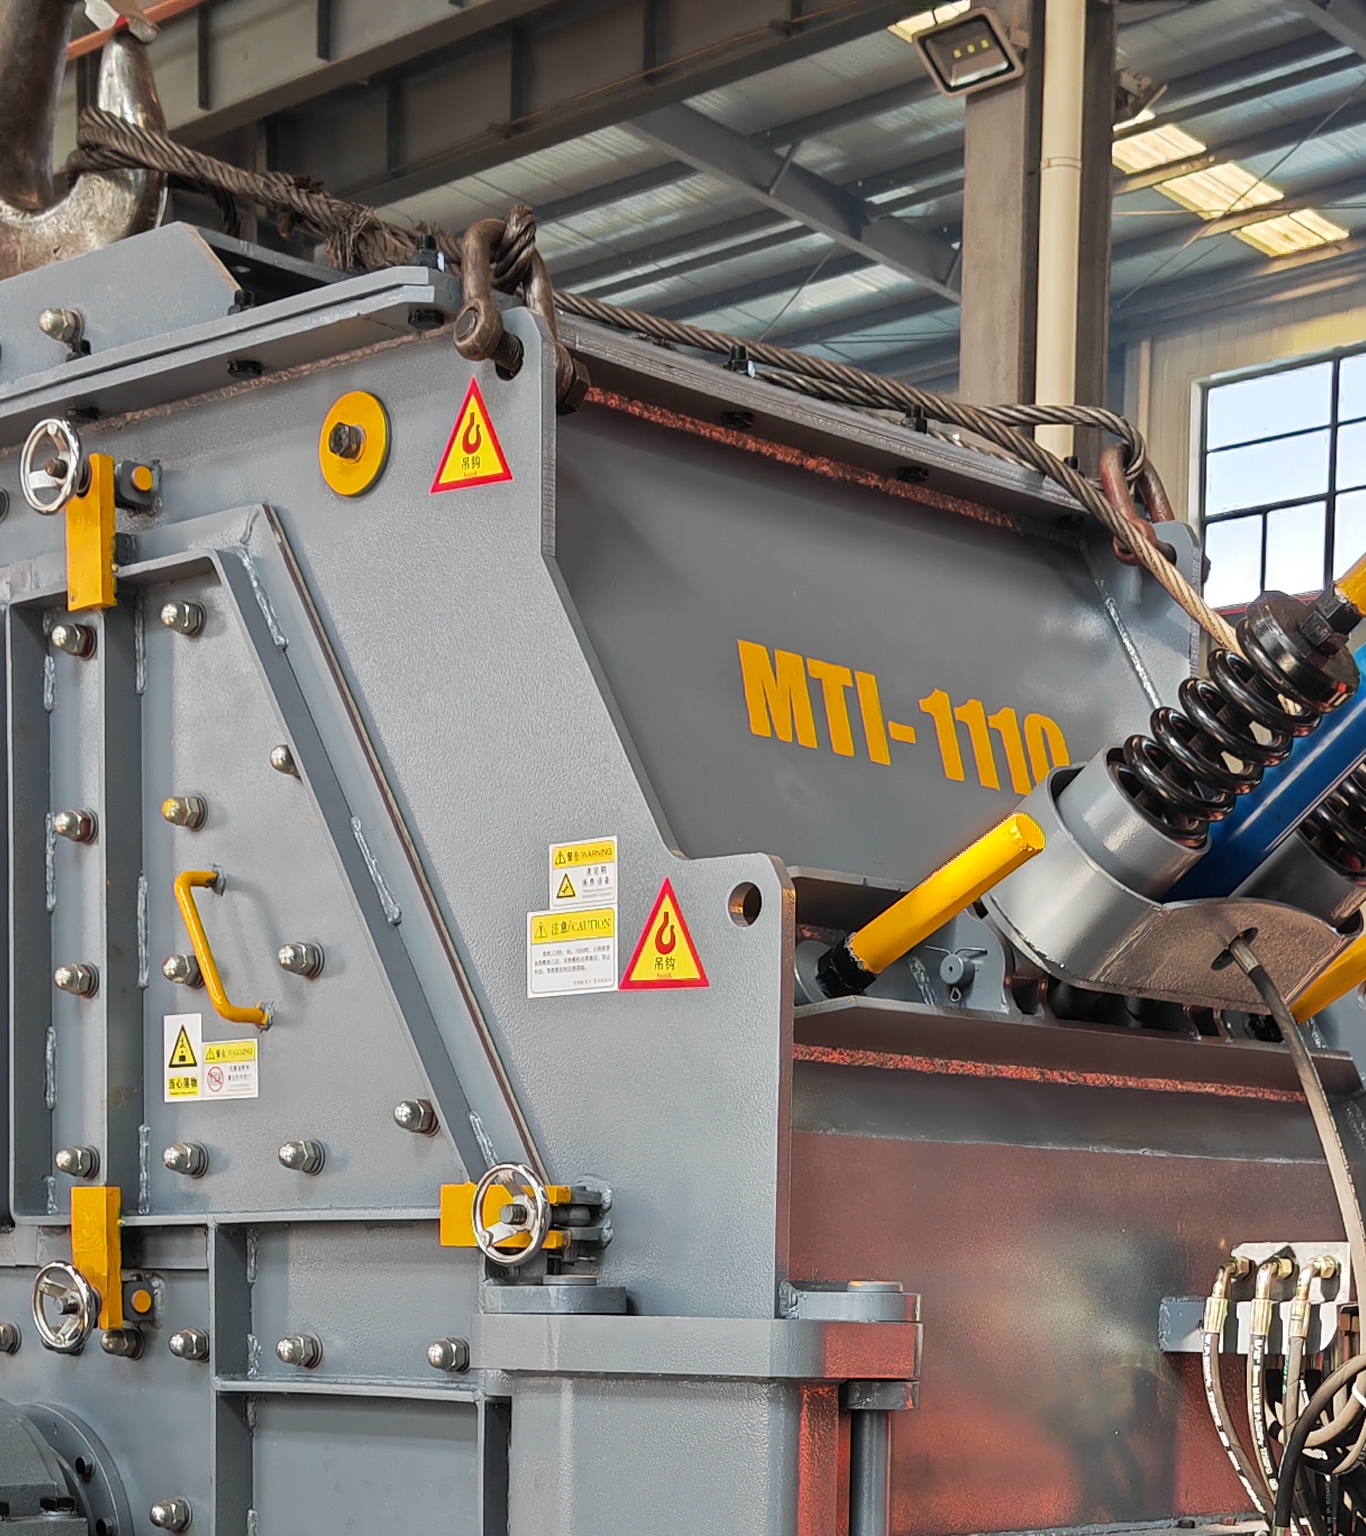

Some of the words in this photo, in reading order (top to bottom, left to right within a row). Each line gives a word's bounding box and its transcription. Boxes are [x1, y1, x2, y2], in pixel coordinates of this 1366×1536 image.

[461, 455, 481, 470] 吊钩
[737, 638, 1070, 796] MTI-1110
[654, 956, 676, 970] 吊钩
